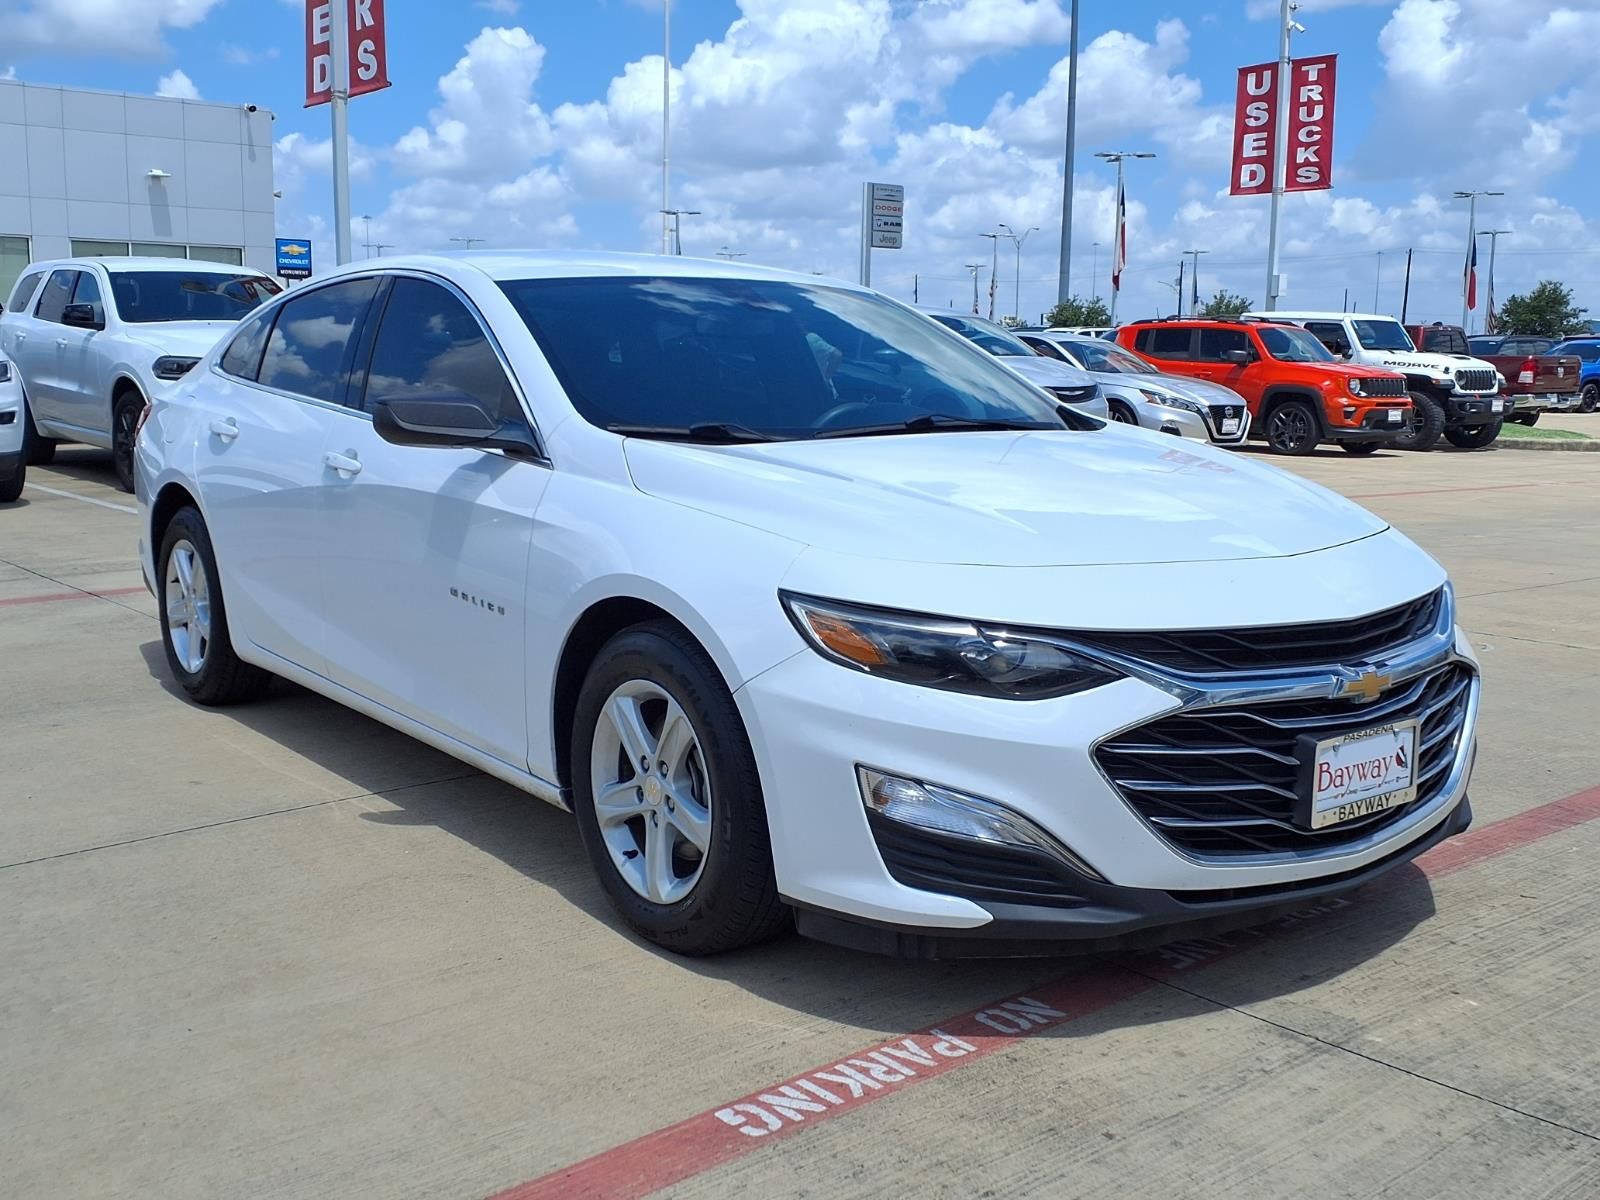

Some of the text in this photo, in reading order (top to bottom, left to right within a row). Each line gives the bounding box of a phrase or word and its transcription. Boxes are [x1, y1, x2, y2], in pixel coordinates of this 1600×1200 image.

[1240, 70, 1272, 188] USED
[1296, 63, 1327, 183] TRUCKS
[879, 233, 897, 245] Jeep
[1383, 360, 1441, 370] MOJAVE
[1317, 755, 1393, 798] Bayway
[1338, 793, 1392, 821] BAYWAY
[713, 996, 1068, 1137] NO PARKING
